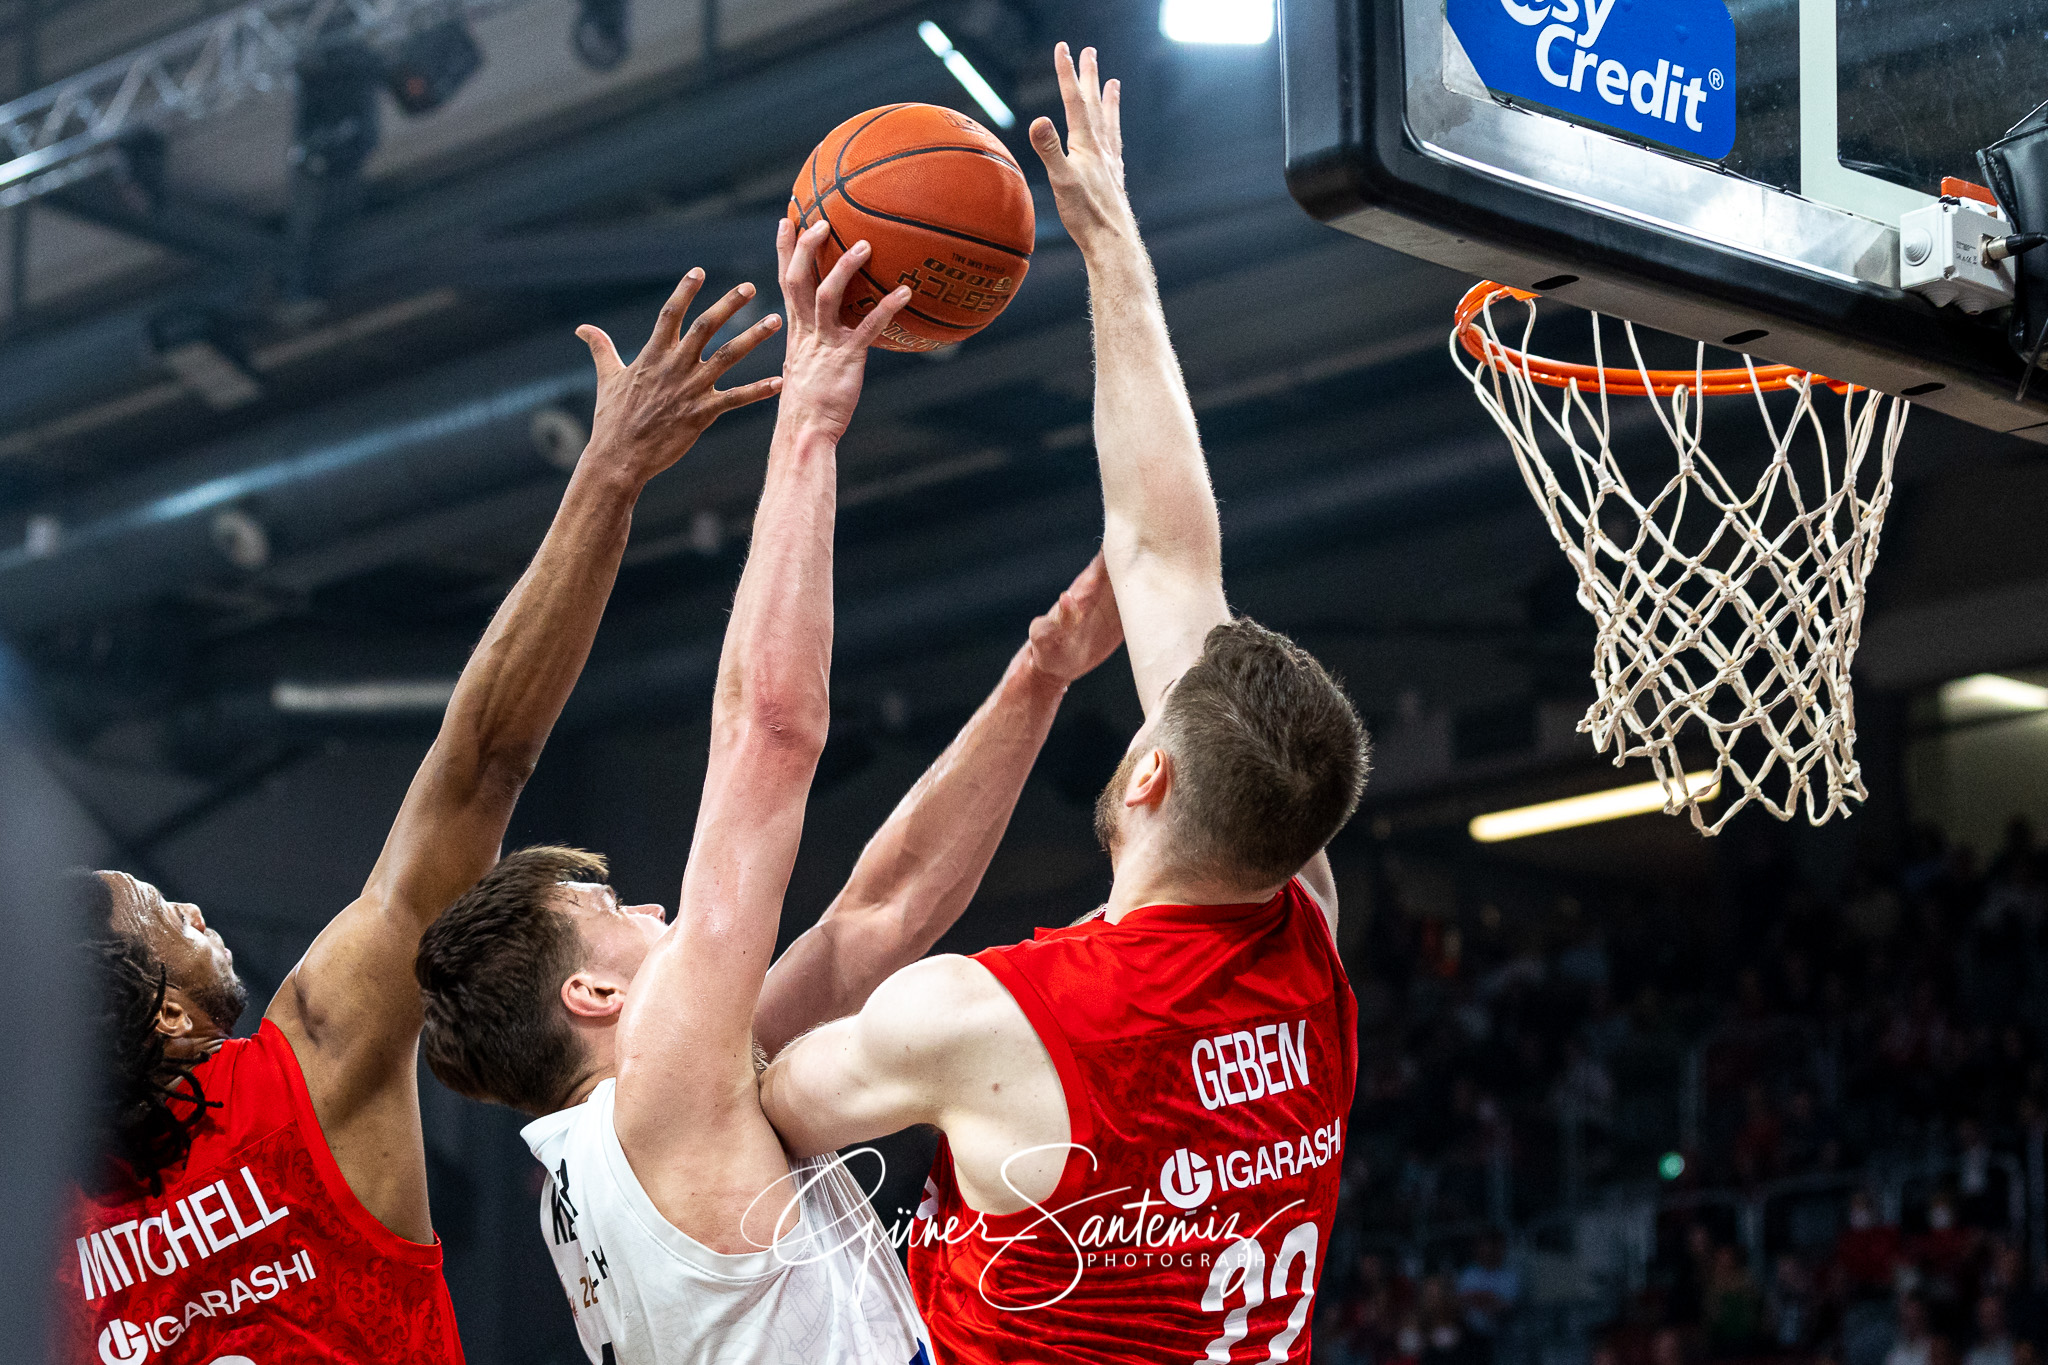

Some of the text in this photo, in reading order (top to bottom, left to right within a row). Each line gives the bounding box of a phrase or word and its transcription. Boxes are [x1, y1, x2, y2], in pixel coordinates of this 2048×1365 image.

[1191, 1020, 1310, 1111] GEBEN
[76, 1166, 289, 1301] MITCHELL
[145, 1249, 316, 1353] IGARASHI
